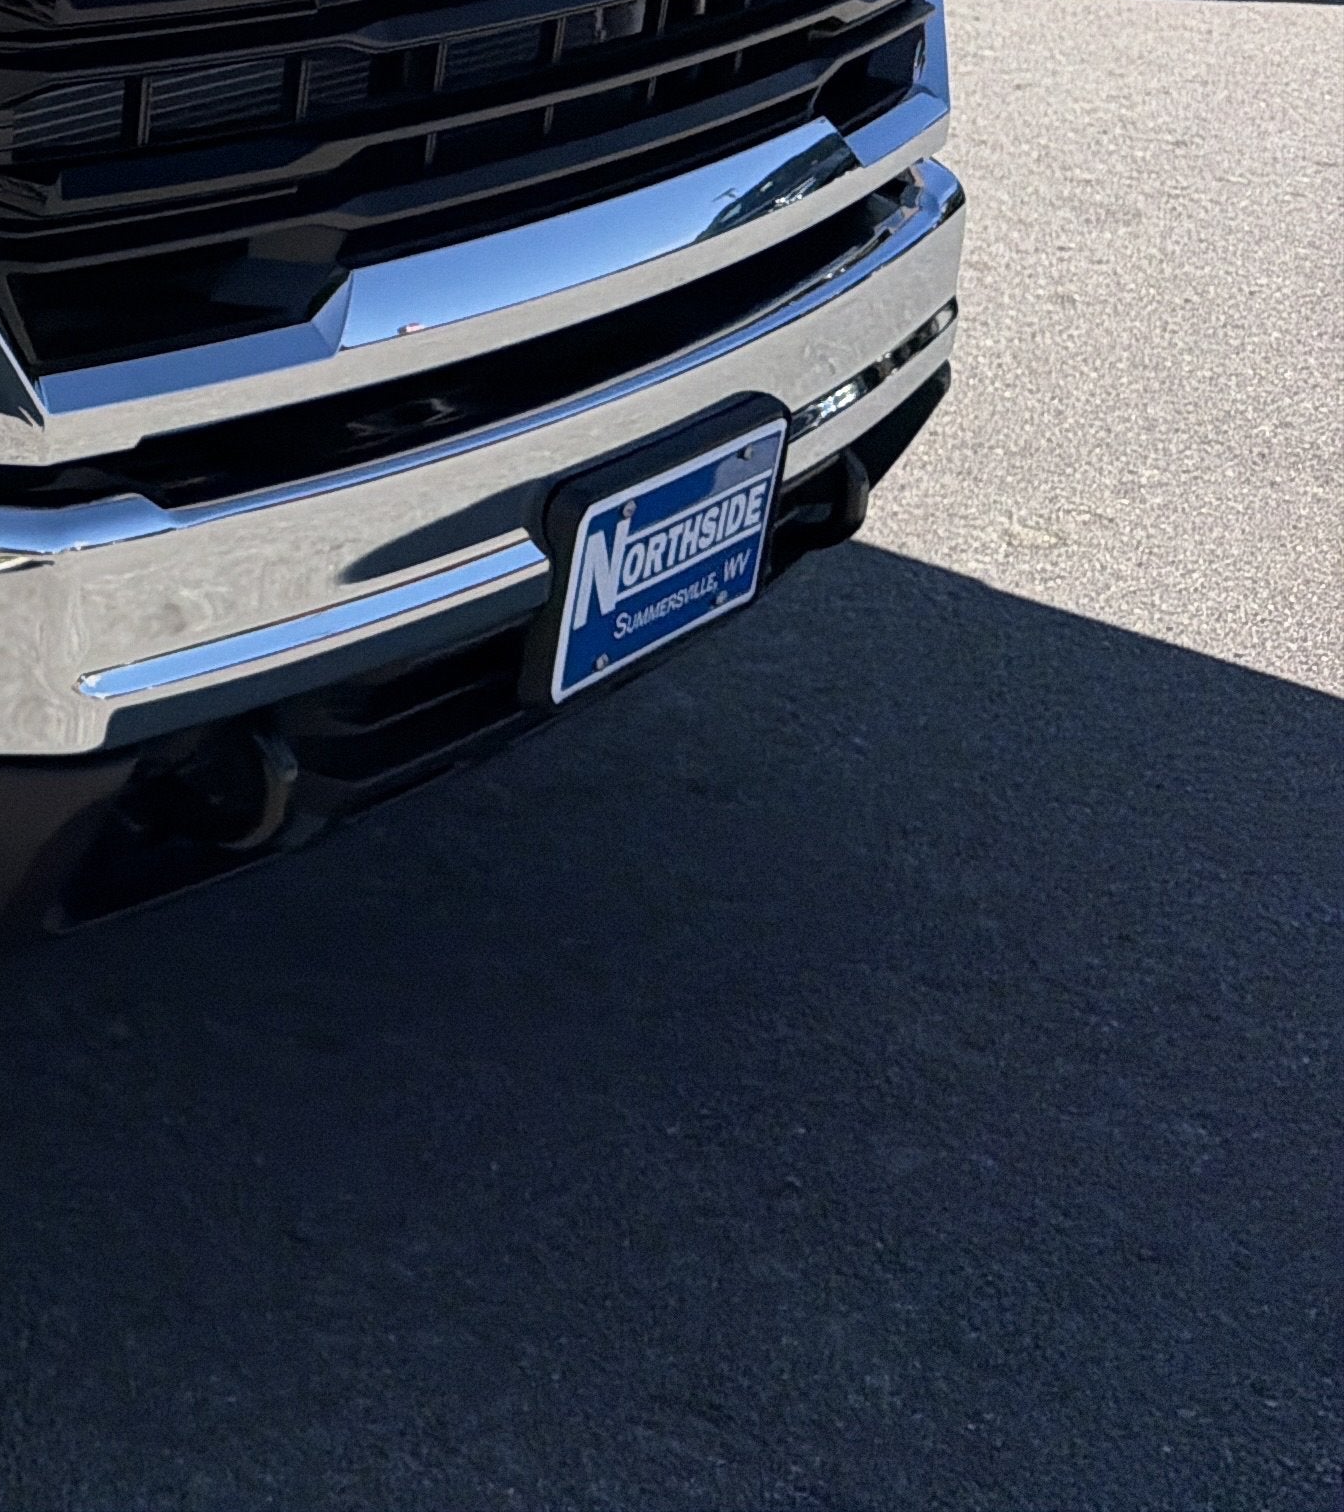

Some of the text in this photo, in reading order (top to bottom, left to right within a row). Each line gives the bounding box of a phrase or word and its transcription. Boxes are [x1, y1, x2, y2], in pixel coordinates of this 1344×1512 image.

[572, 481, 769, 631] NORTHSIDE
[613, 548, 752, 639] SUMMERSVILLE, WV
